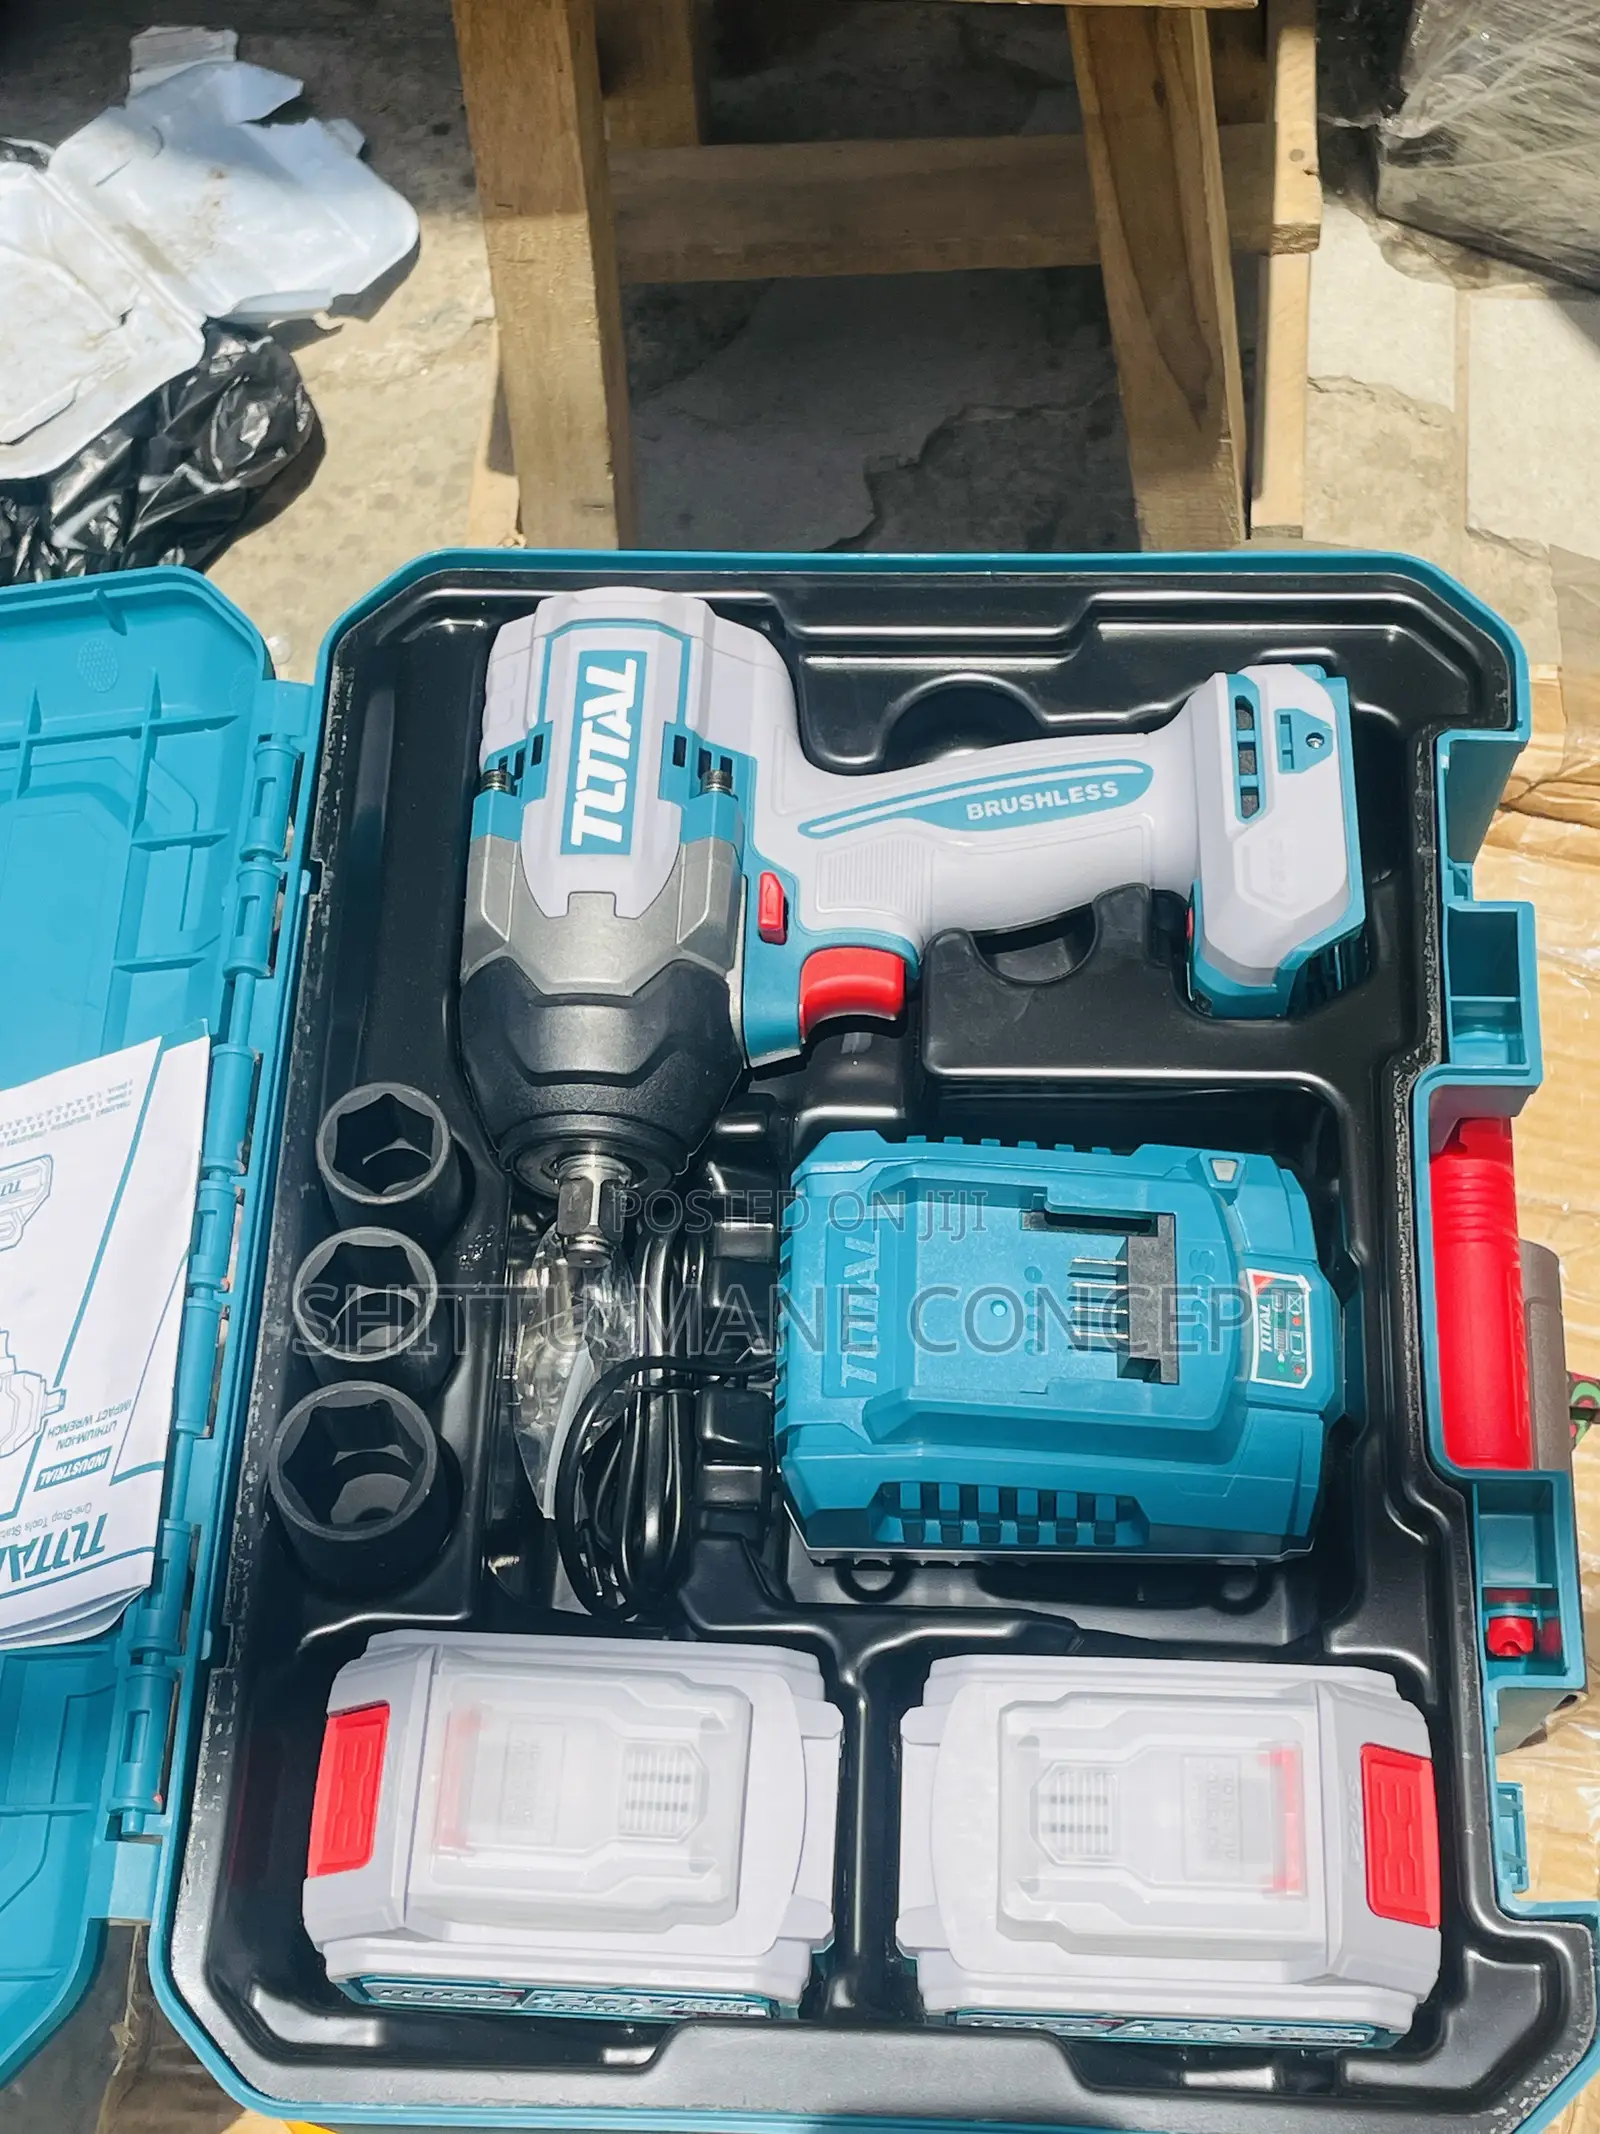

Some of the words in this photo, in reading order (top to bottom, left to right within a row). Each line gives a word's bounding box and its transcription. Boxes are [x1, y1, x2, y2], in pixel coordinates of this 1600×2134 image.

[570, 658, 637, 846] TOTAL
[966, 780, 1119, 821] BRUSHLESS
[1259, 1303, 1273, 1353] TOTAL
[47, 1414, 94, 1442] WRENCH
[56, 1419, 118, 1451] LITHIUM-ION
[39, 1451, 109, 1486] INDUSTRIAL
[0, 1512, 109, 1583] TOTA
